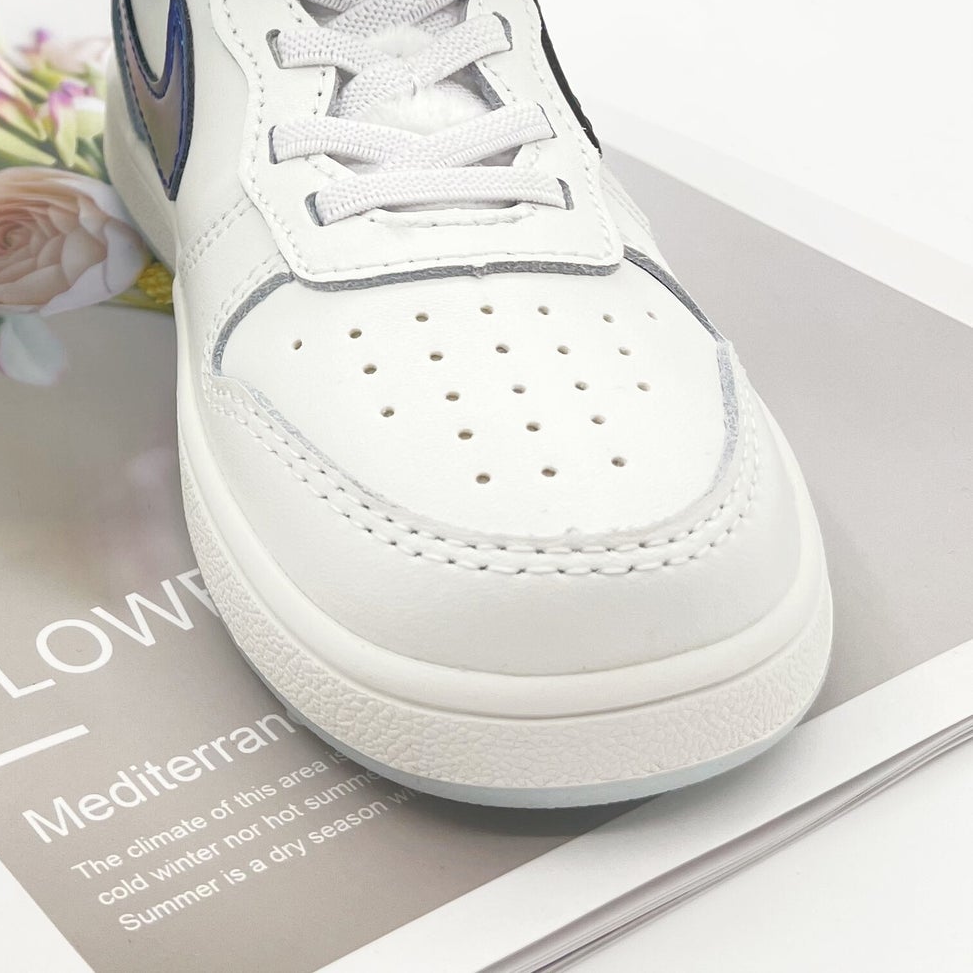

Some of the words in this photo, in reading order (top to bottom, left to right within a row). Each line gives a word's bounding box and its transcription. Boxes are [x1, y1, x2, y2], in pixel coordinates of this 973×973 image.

[70, 854, 124, 879] The
[126, 816, 208, 858] climate
[210, 799, 235, 820] of
[233, 785, 277, 808] this
[279, 760, 330, 789] area
[98, 873, 150, 906] cold
[148, 842, 221, 881] winter
[222, 823, 262, 849] nor
[261, 803, 305, 830] hot
[118, 878, 221, 931] Summer
[219, 868, 248, 885] is
[249, 858, 269, 873] a
[269, 838, 307, 863] dry
[308, 800, 389, 844] season
